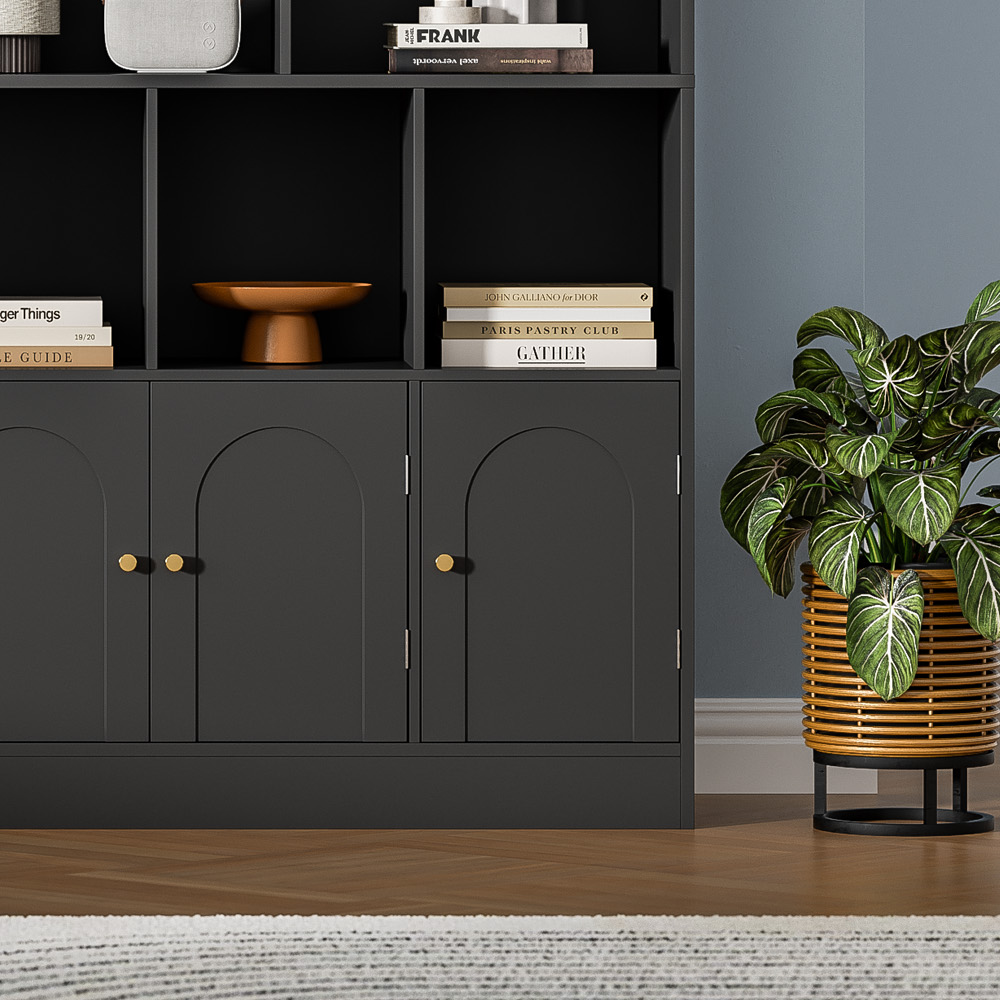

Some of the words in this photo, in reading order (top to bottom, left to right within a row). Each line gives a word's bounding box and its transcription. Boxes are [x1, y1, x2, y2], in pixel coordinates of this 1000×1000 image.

[416, 28, 481, 43] FRANK
[412, 58, 458, 66] vervoordt
[459, 58, 479, 66] axel
[485, 293, 511, 302] JOHN
[512, 293, 561, 302] GALLIANO
[561, 293, 573, 302] for
[574, 293, 599, 302] DIOR
[20, 307, 61, 323] Things
[481, 326, 521, 335] PARIS
[526, 326, 577, 335] PASTRY
[583, 326, 620, 335] CLUB
[20, 352, 73, 363] GUIDE
[517, 346, 586, 361] GATHER
